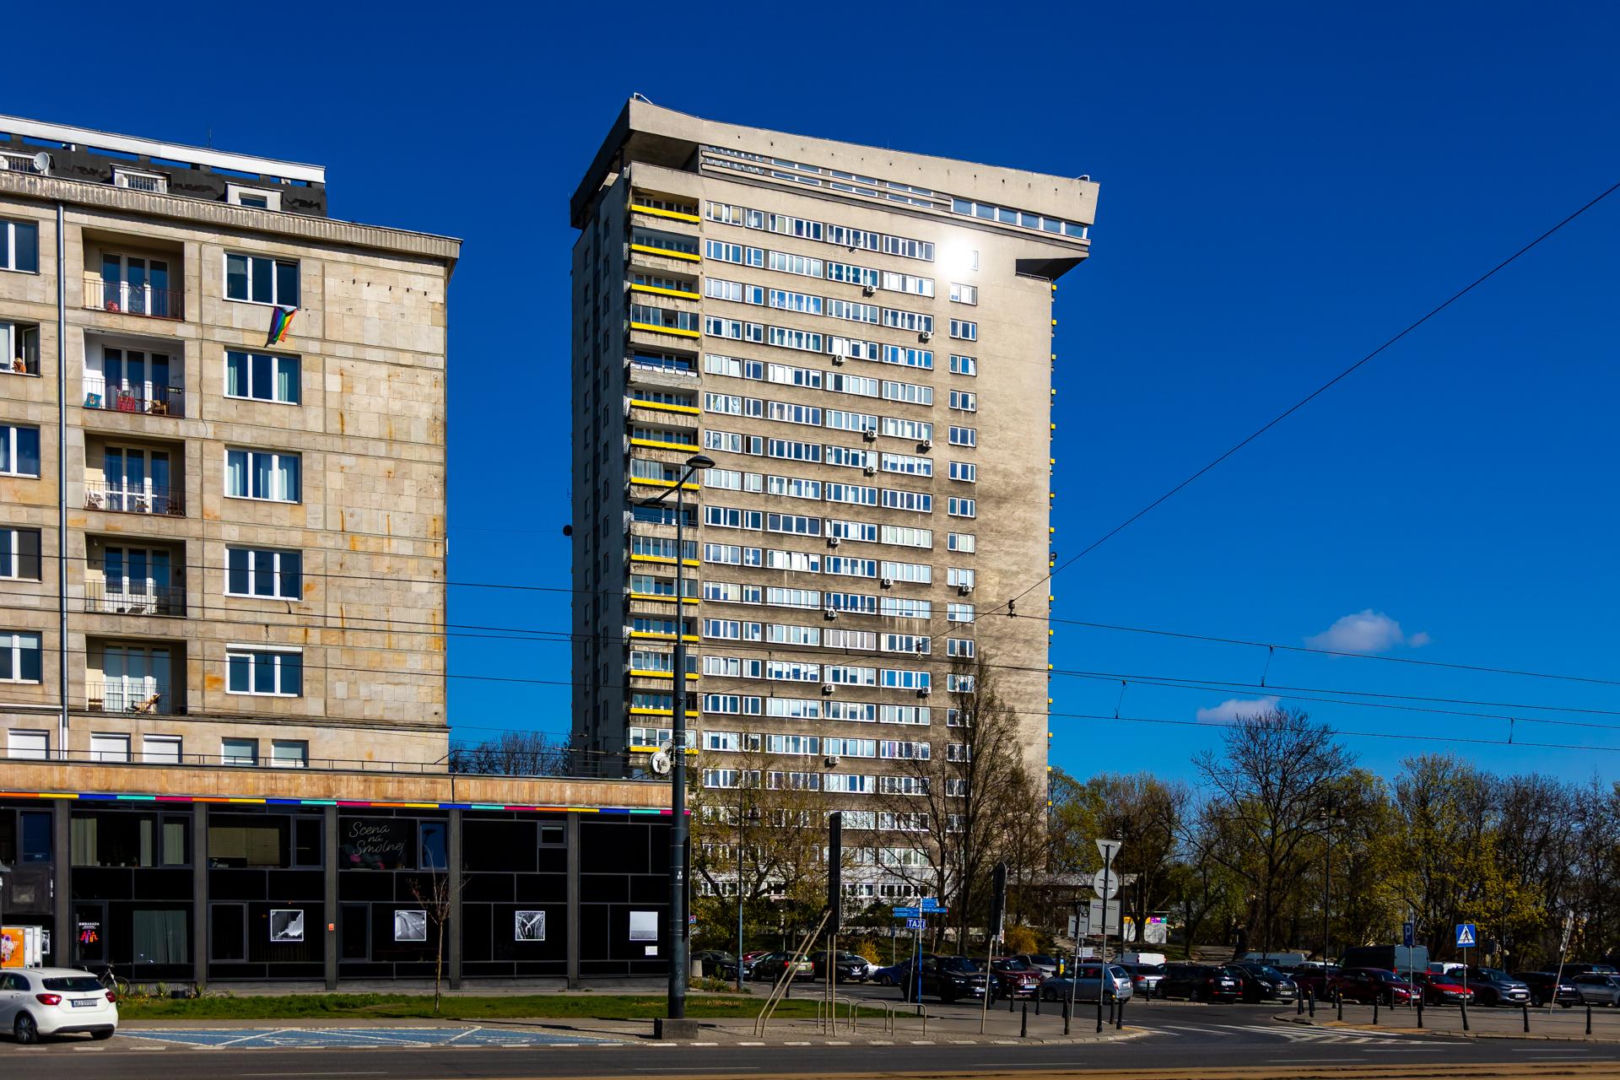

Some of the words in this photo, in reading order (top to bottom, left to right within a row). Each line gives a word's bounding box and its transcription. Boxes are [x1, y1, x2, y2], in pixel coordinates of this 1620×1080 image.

[348, 821, 390, 838] Scena
[908, 919, 925, 928] TAXI
[1404, 924, 1411, 939] P
